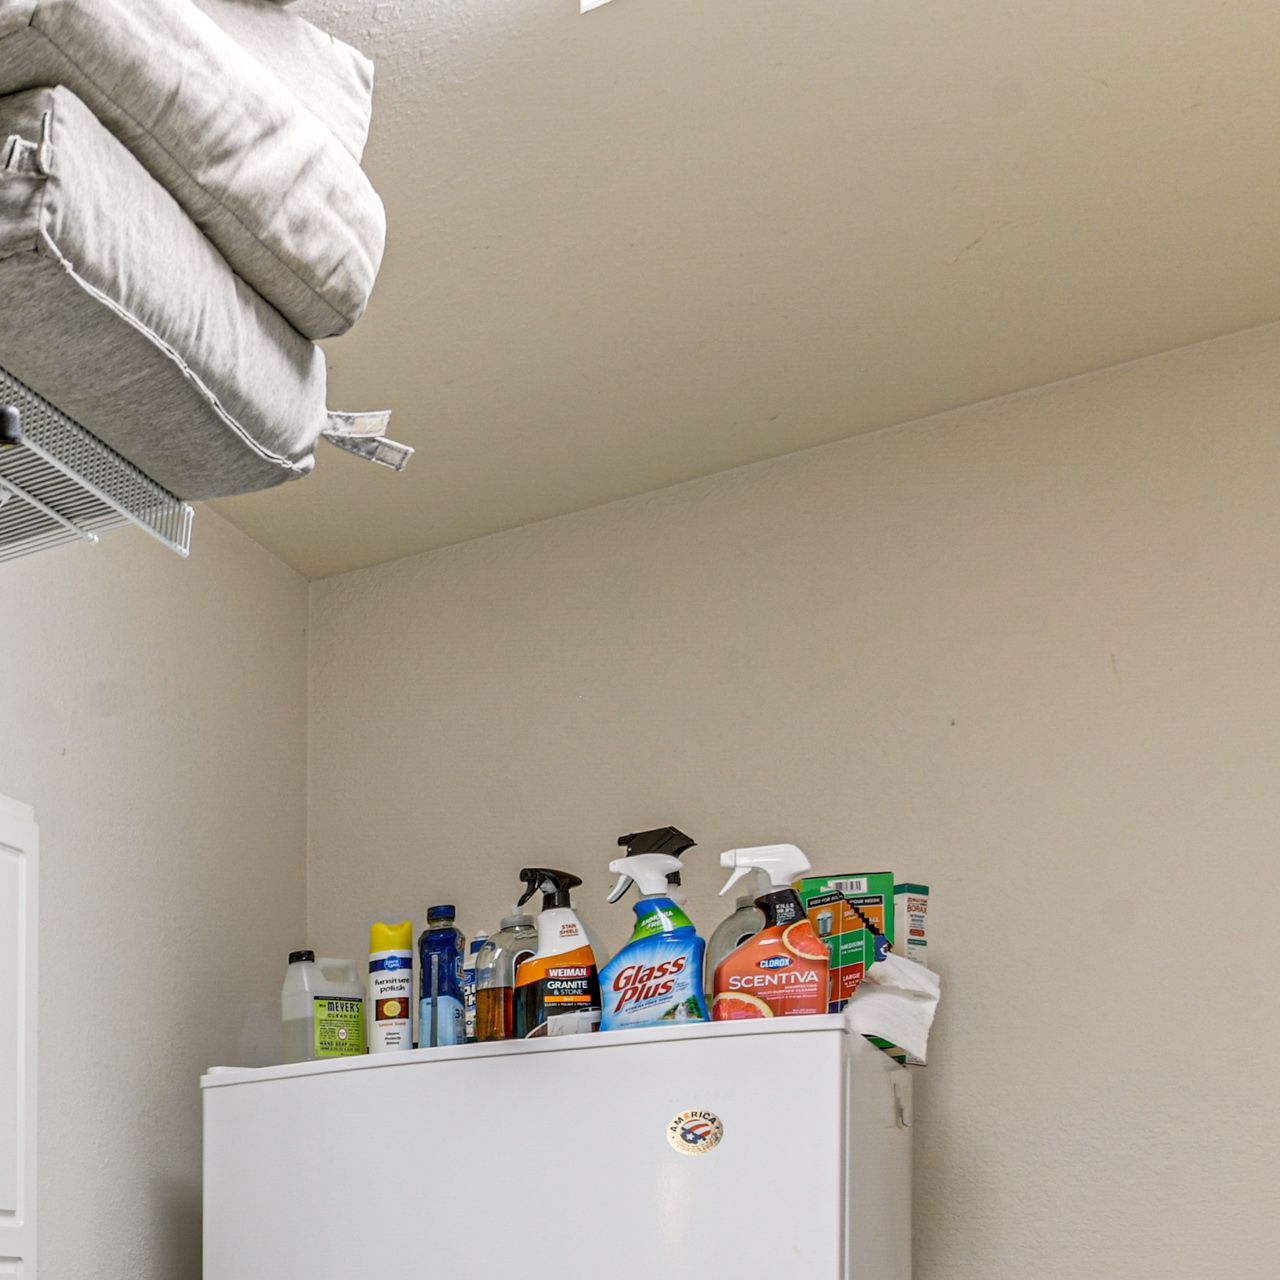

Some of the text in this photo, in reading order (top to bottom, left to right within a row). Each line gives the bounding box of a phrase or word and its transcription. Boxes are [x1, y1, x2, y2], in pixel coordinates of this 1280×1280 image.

[759, 958, 791, 968] CLOROX
[548, 967, 587, 978] WEIMAN
[613, 956, 686, 992] Glass
[380, 983, 406, 994] polish
[547, 980, 589, 990] GRANITE
[613, 979, 675, 1014] Plus
[327, 1001, 360, 1013] MEYER'S
[669, 1111, 717, 1132] AMERICA
